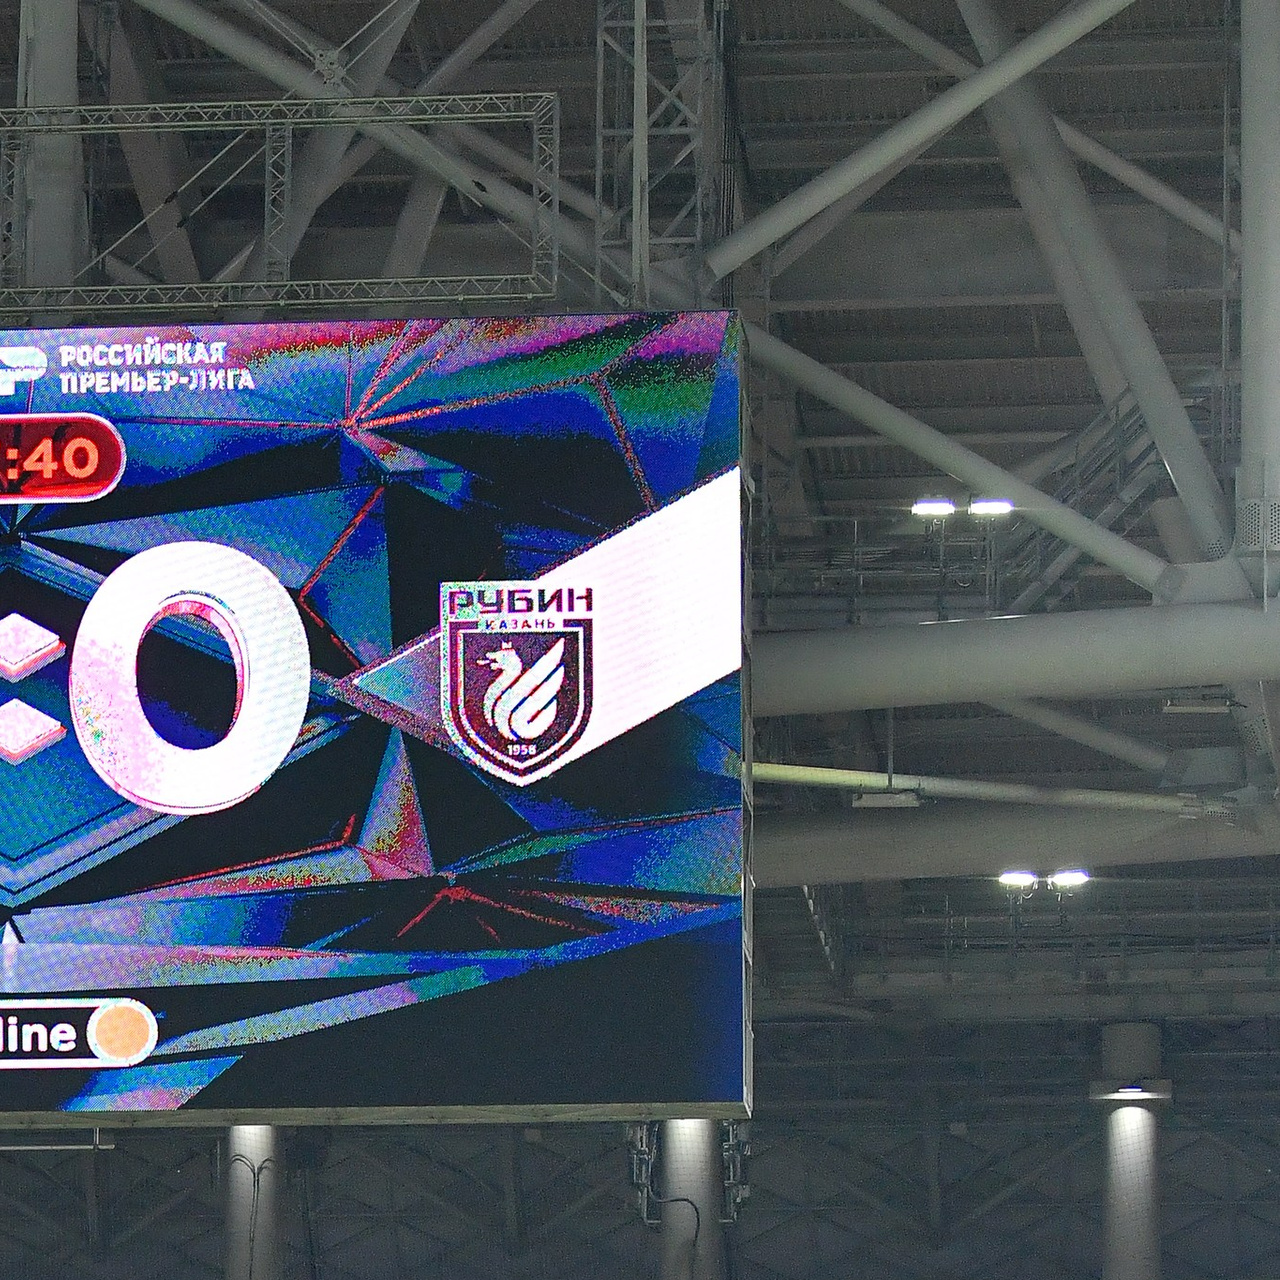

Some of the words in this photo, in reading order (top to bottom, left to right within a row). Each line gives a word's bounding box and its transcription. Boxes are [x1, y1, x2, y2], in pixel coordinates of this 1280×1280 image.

[59, 337, 226, 367] РОССИЙСКАЯ
[59, 367, 255, 395] ПРЕМЬЕР-ЛИГА
[449, 587, 593, 615] РУБИН
[486, 618, 556, 630] КАЗАНЬ
